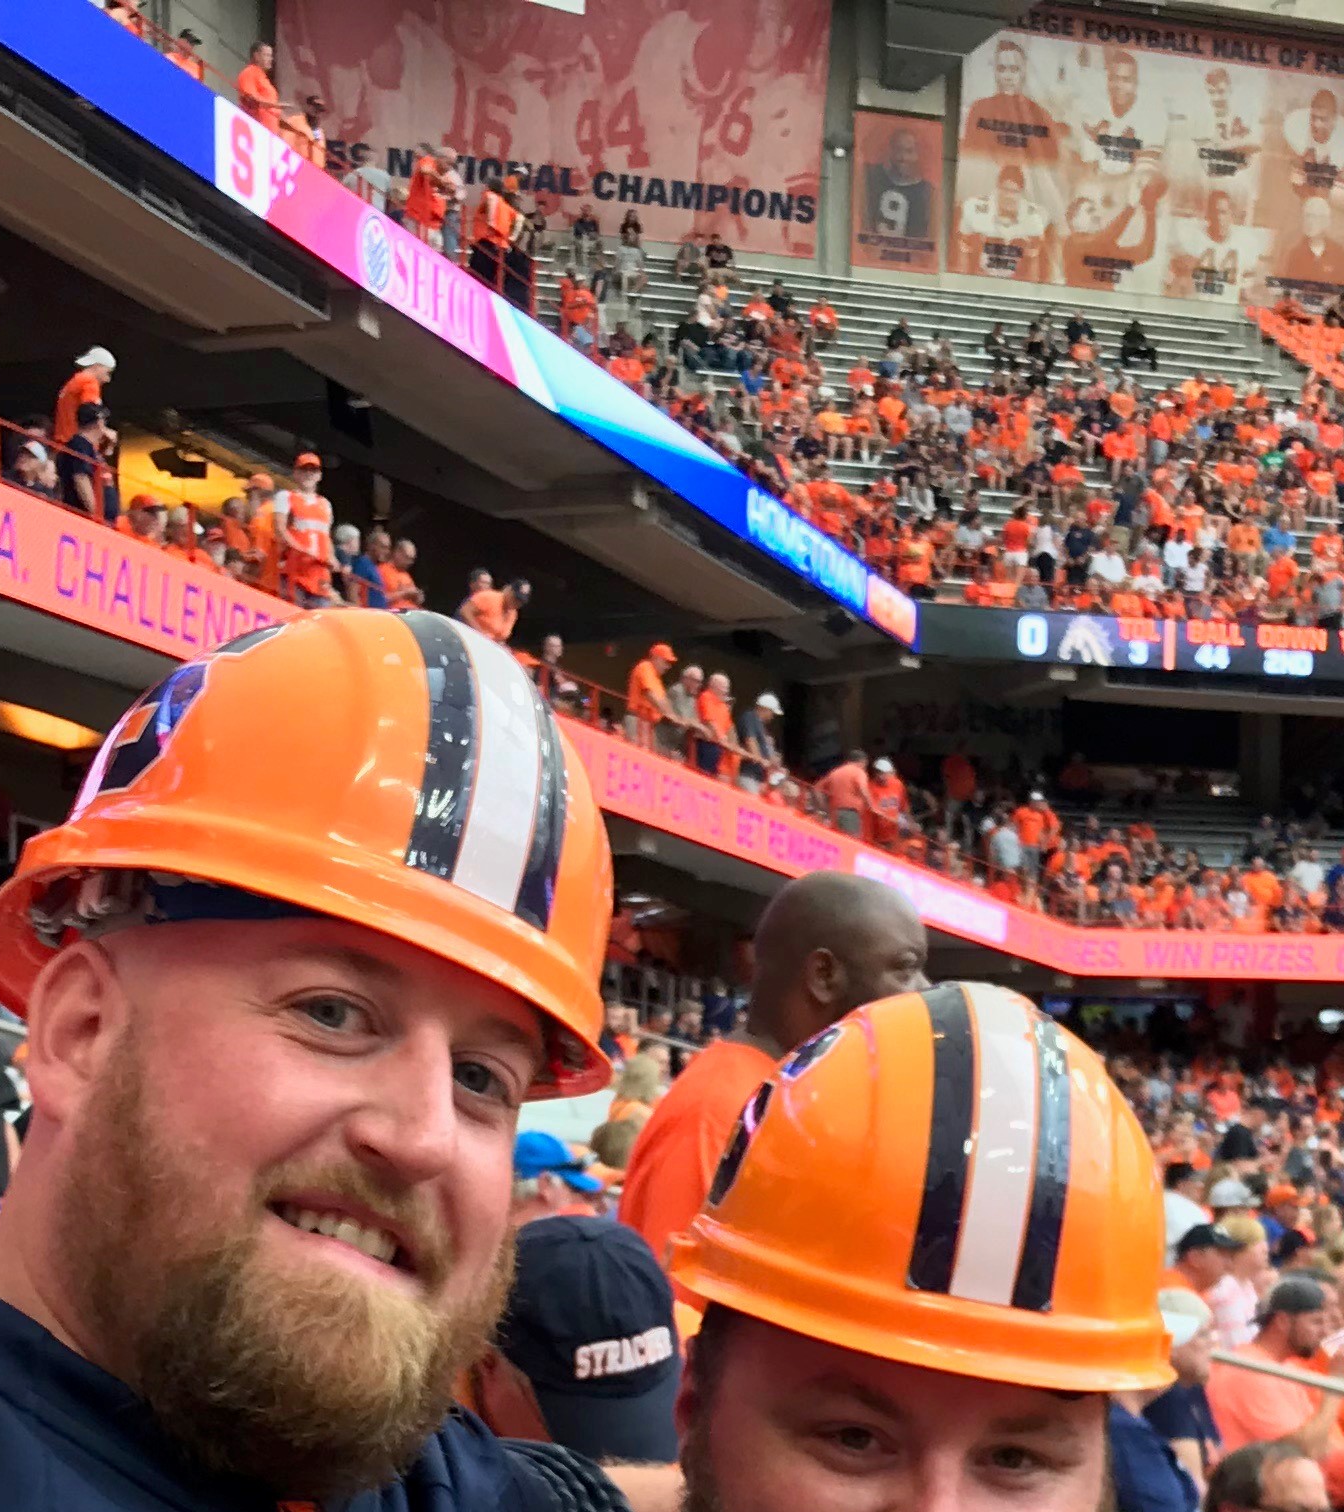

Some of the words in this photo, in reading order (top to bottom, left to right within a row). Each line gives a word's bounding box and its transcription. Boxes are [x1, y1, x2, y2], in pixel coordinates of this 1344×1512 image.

[1082, 19, 1204, 55] FOOTBALL
[592, 171, 816, 225] CHAMPIONS
[56, 533, 271, 650] CHALLEN
[1186, 619, 1246, 647] BALL
[1258, 625, 1328, 653] DOWN
[1194, 644, 1232, 670] 44
[1144, 941, 1202, 969] WIN
